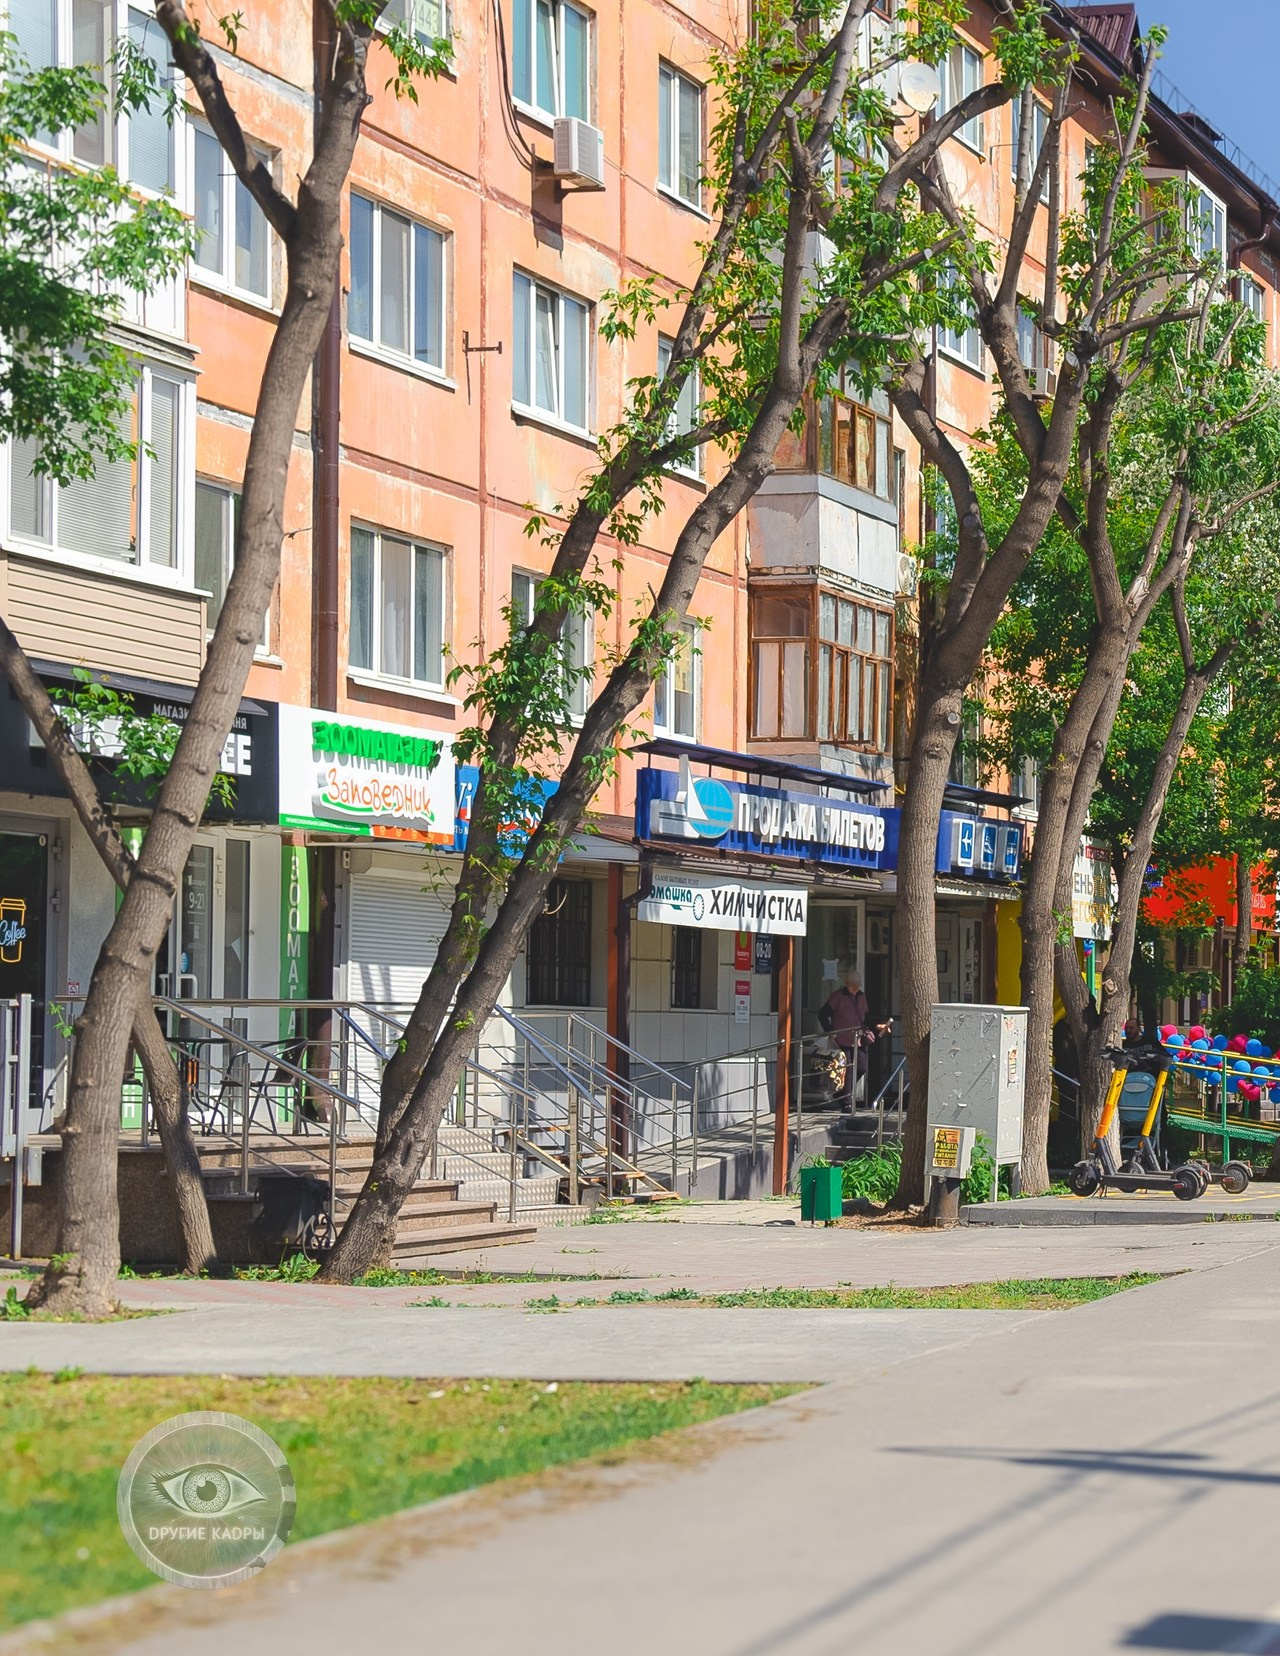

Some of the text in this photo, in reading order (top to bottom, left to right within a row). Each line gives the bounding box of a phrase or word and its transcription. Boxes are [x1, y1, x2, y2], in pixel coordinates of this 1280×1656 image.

[153, 704, 190, 720] МАГАЗИ
[738, 793, 885, 852] ПРОДАЖА БИЛЕТОВ
[650, 885, 693, 903] омашка
[710, 889, 804, 923] ХИМЧИСТКА
[0, 920, 26, 947] Coffee
[286, 855, 302, 1114] ЗООМАГА
